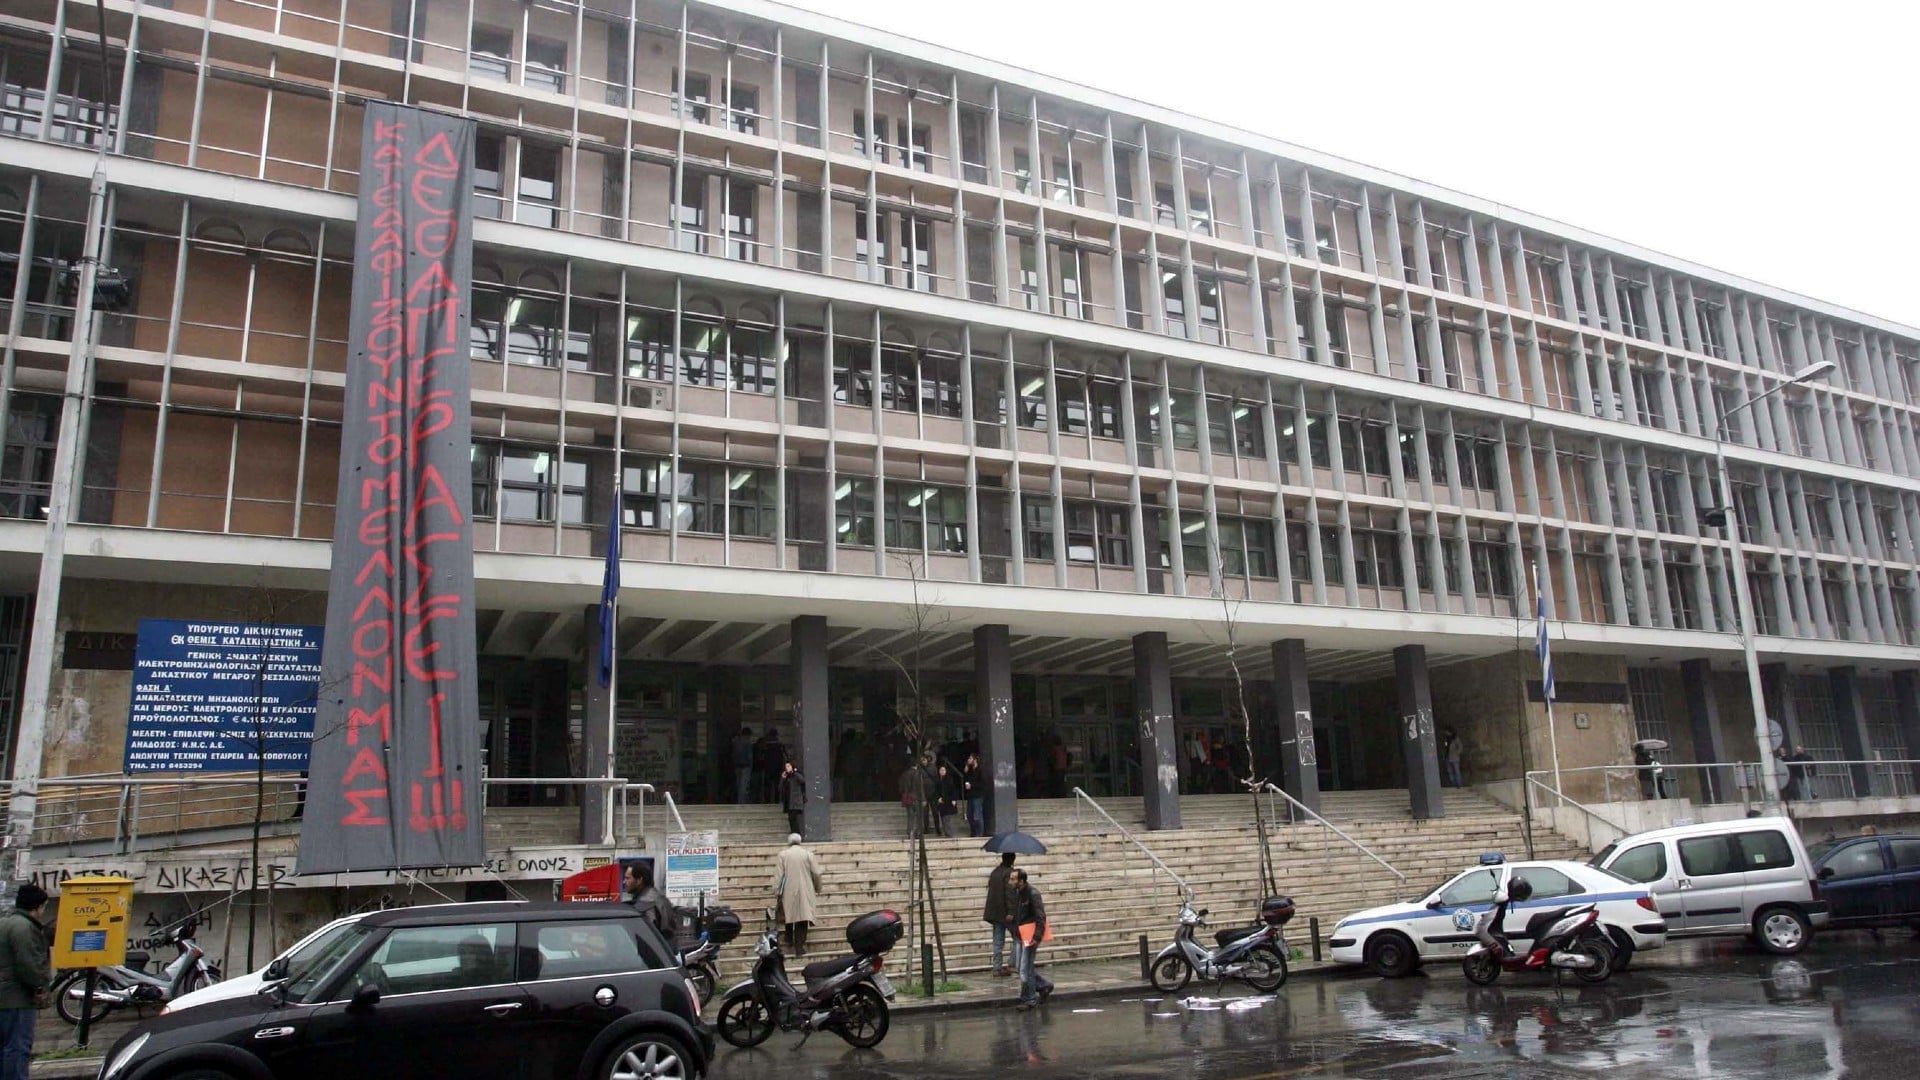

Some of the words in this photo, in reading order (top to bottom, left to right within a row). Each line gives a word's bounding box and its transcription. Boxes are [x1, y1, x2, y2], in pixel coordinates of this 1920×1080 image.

[188, 625, 239, 635] ΥΠΟΥΡΓΕΙΟ
[244, 627, 303, 637] ΔΙΚΑΙΟΣΥΝΗΣ
[187, 636, 216, 645] ΘΕΜΙΣ
[223, 637, 301, 647] ΚΑΤΑΣΚΕΥΑΣΤΙΚΗ
[187, 652, 221, 660] ΓΕΝΙΚΗ
[151, 671, 208, 679] ΔΙΚΑΣΤΙΚΟΥ
[213, 672, 256, 680] ΜΕΓΑΡΟΥ
[136, 684, 160, 692] ΦΑΣΗ
[135, 694, 204, 702] ΑΝΑΚΑΤΑΣΚΕΥΗ
[208, 695, 280, 704] ΜΗΧΑΝΟΛΟΓΚΩΝ
[193, 705, 268, 713] ΗΛΕΚΤΡΟΛΟΓΙΚΝ
[130, 752, 170, 760] ΑΝΩΝΥΜΗ
[518, 857, 573, 872] ΟΛΟΥΣ
[74, 906, 96, 914] ΕΛΤΑ
